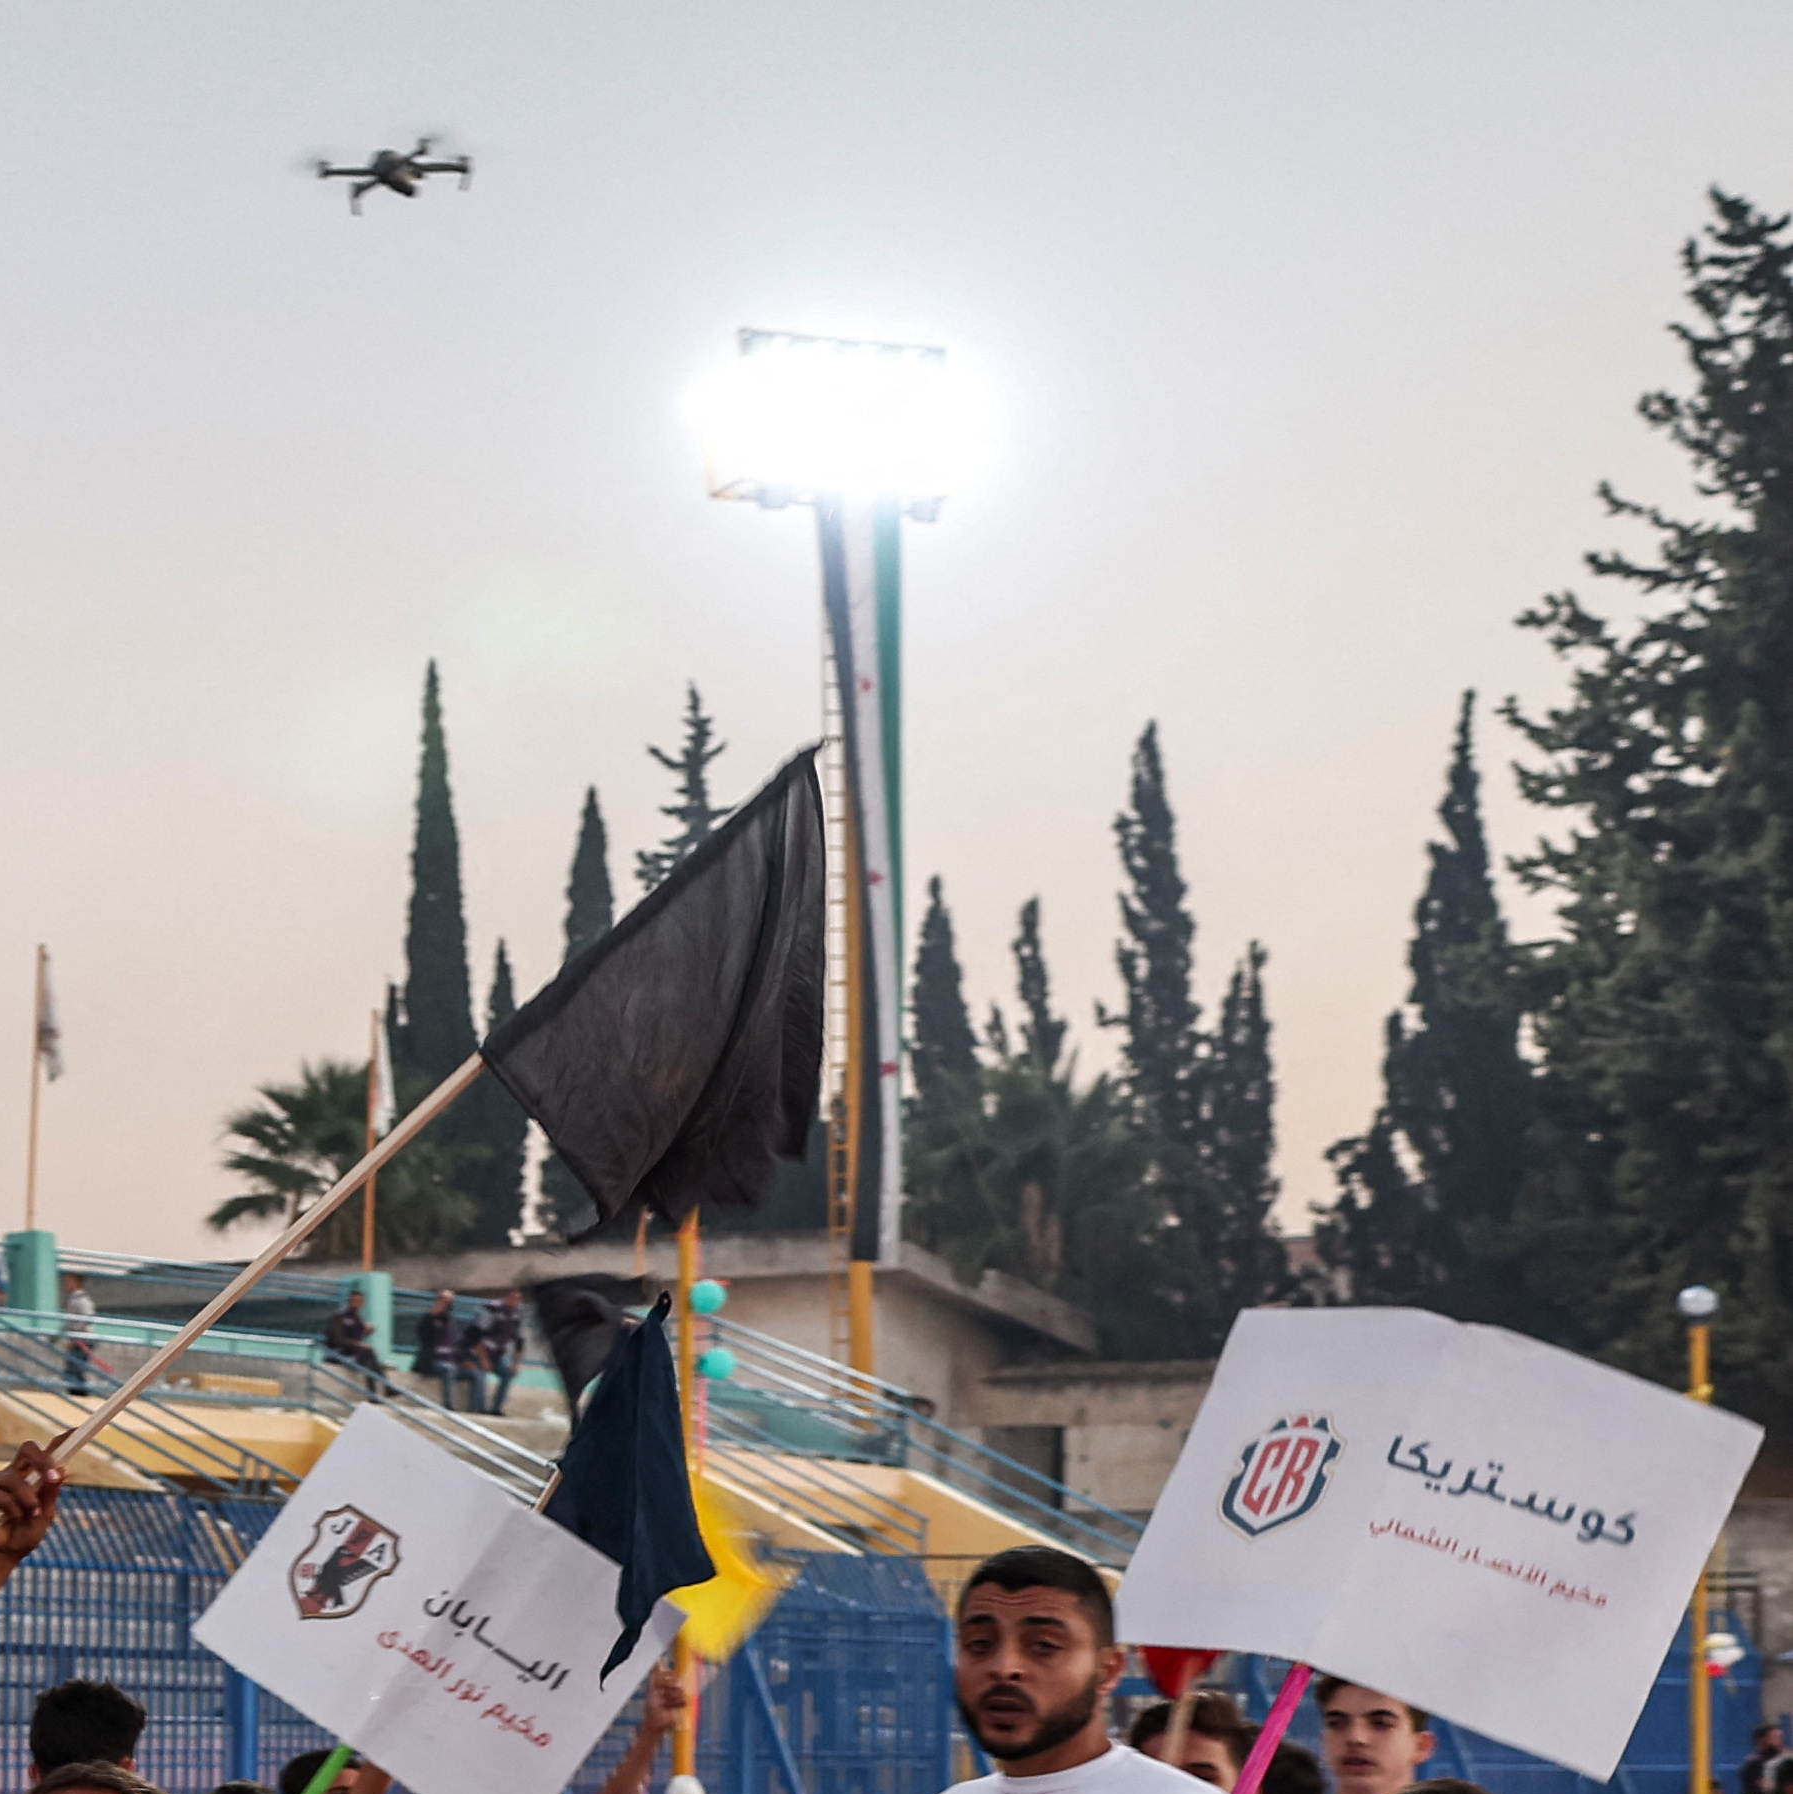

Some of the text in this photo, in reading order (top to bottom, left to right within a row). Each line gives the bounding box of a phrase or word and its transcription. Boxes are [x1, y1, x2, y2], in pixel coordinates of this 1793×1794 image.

[1242, 1437, 1321, 1516] CR
[1387, 1434, 1638, 1546] كوستريكا
[423, 1590, 572, 1691] اليابان
